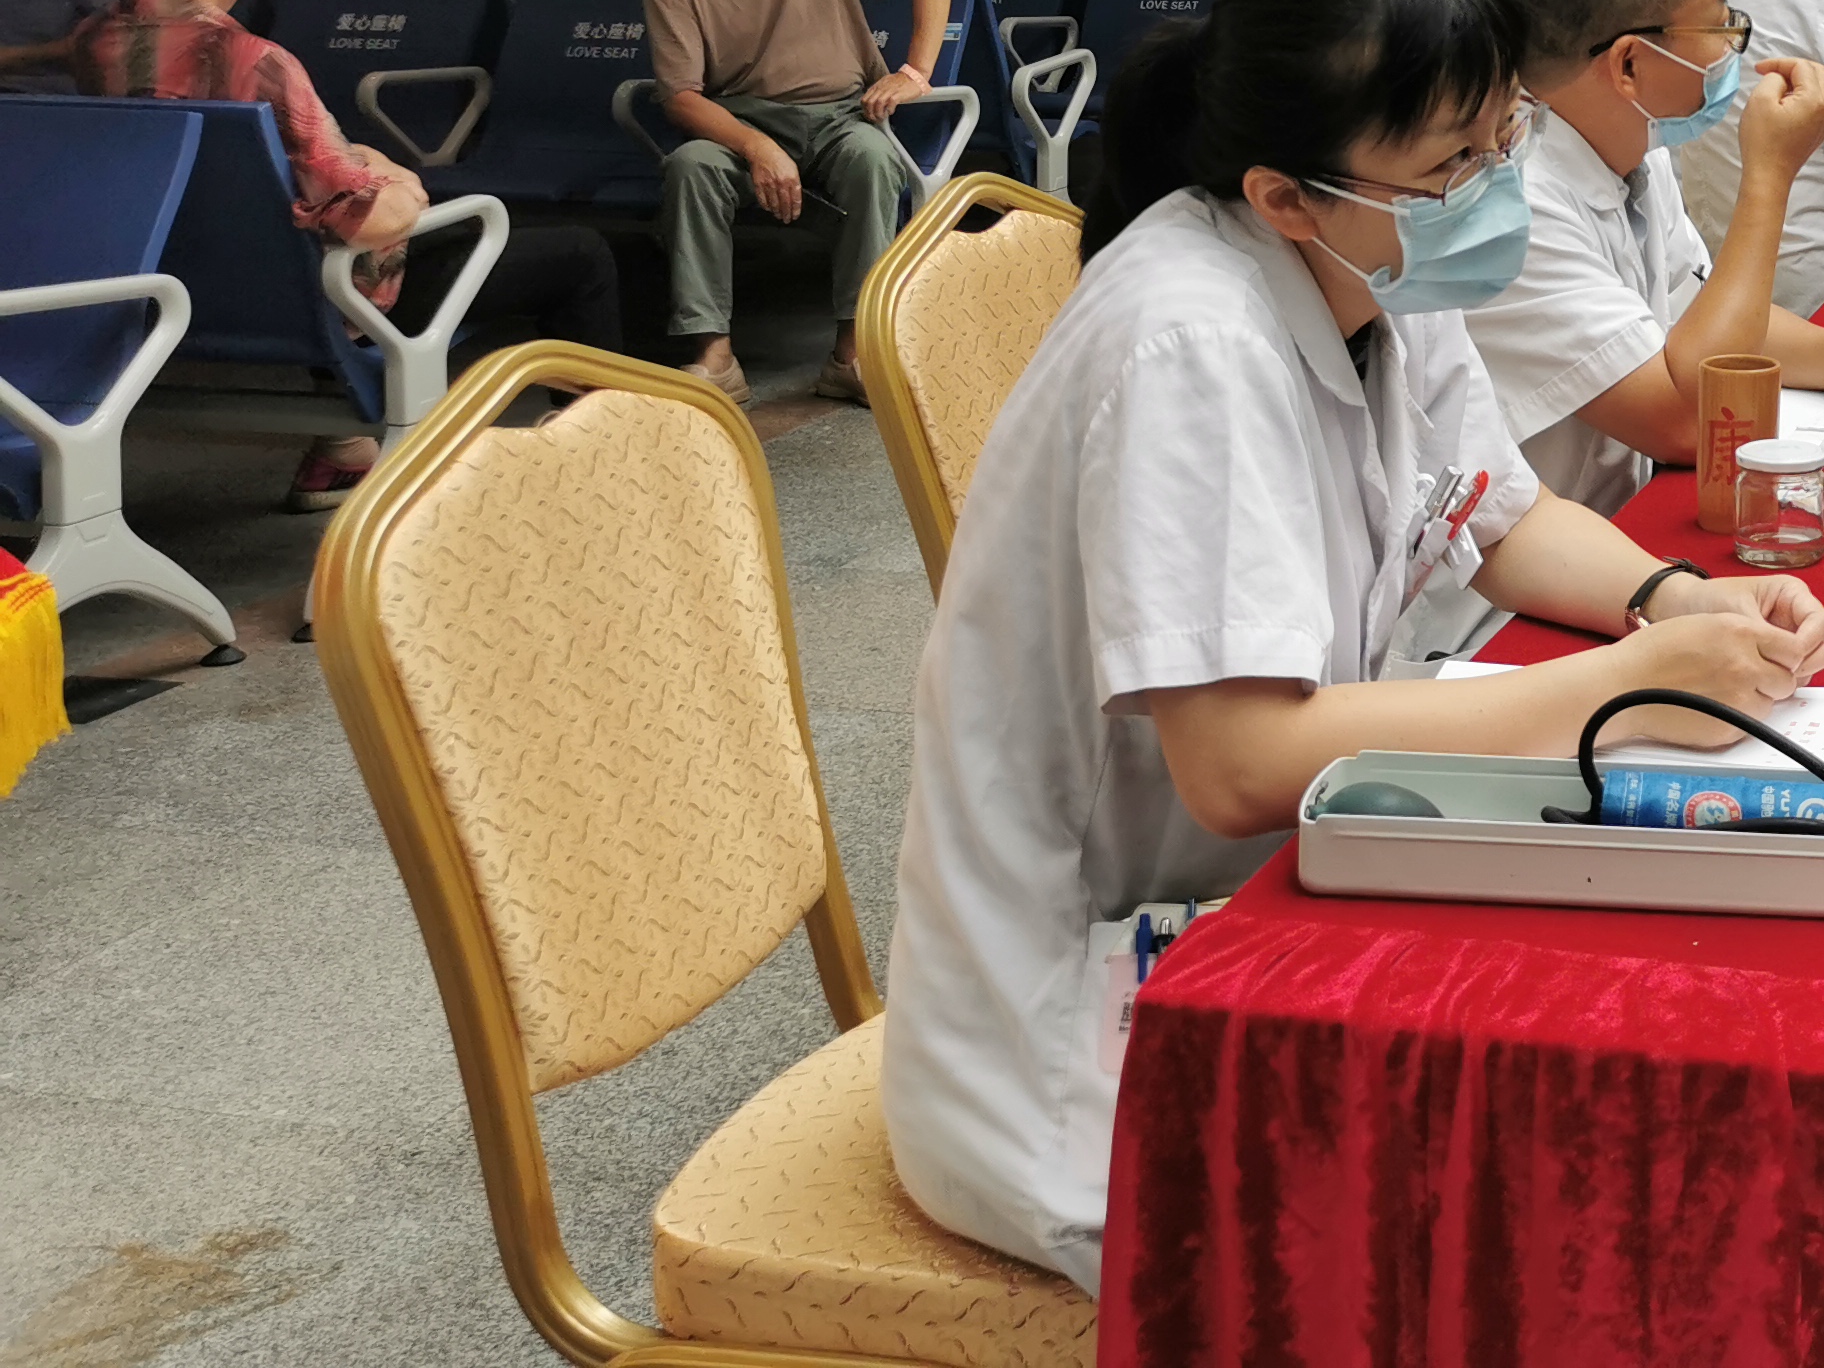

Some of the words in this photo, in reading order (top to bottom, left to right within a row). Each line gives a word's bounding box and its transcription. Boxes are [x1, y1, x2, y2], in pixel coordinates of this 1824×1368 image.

[1140, 0, 1168, 10] LOVE
[1171, 0, 1199, 10] SEAT
[336, 13, 407, 32] 爱心座椅
[572, 22, 645, 41] 爱心座椅
[328, 38, 364, 50] LOVE
[366, 38, 400, 50] SEAT
[566, 46, 602, 58] LOVE
[604, 46, 639, 59] SEAT
